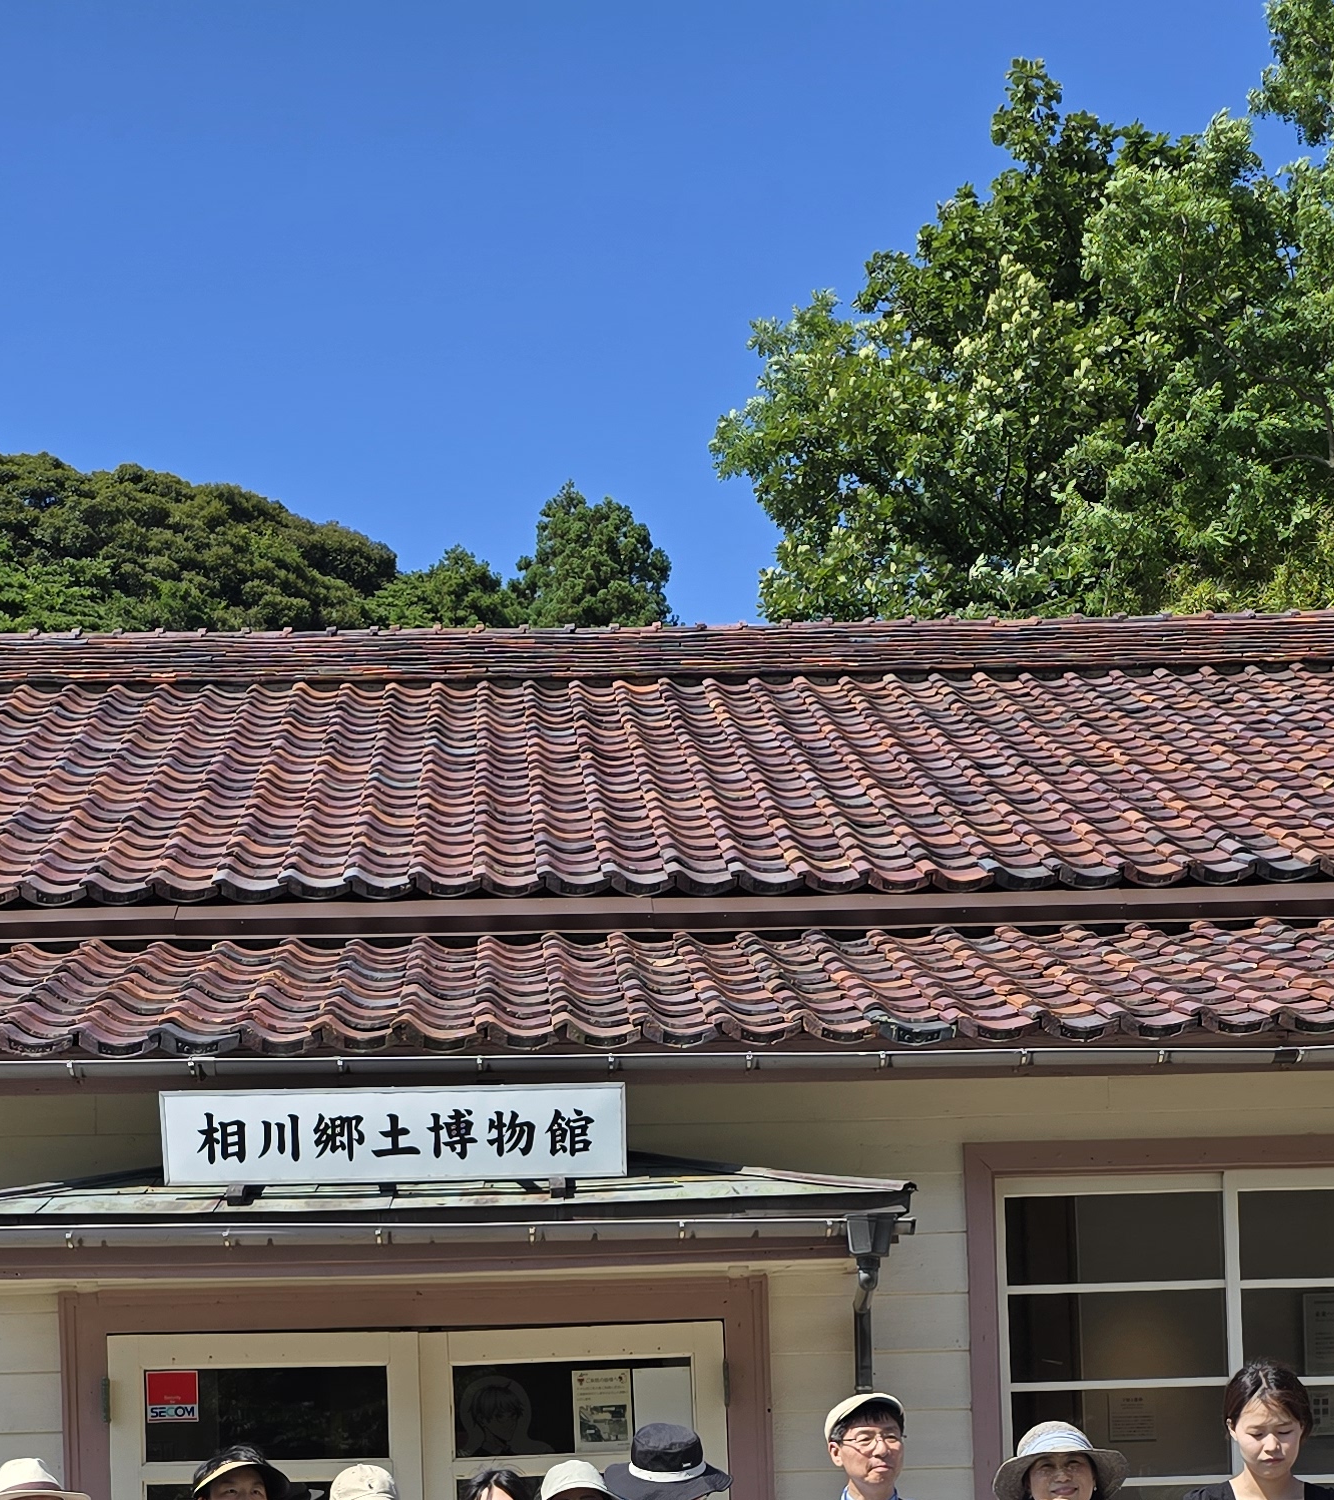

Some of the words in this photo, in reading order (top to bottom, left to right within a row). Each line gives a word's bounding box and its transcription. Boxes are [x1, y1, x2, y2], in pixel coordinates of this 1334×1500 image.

[196, 1108, 595, 1165] 相川郷土博物館
[150, 1406, 195, 1418] SECOM
